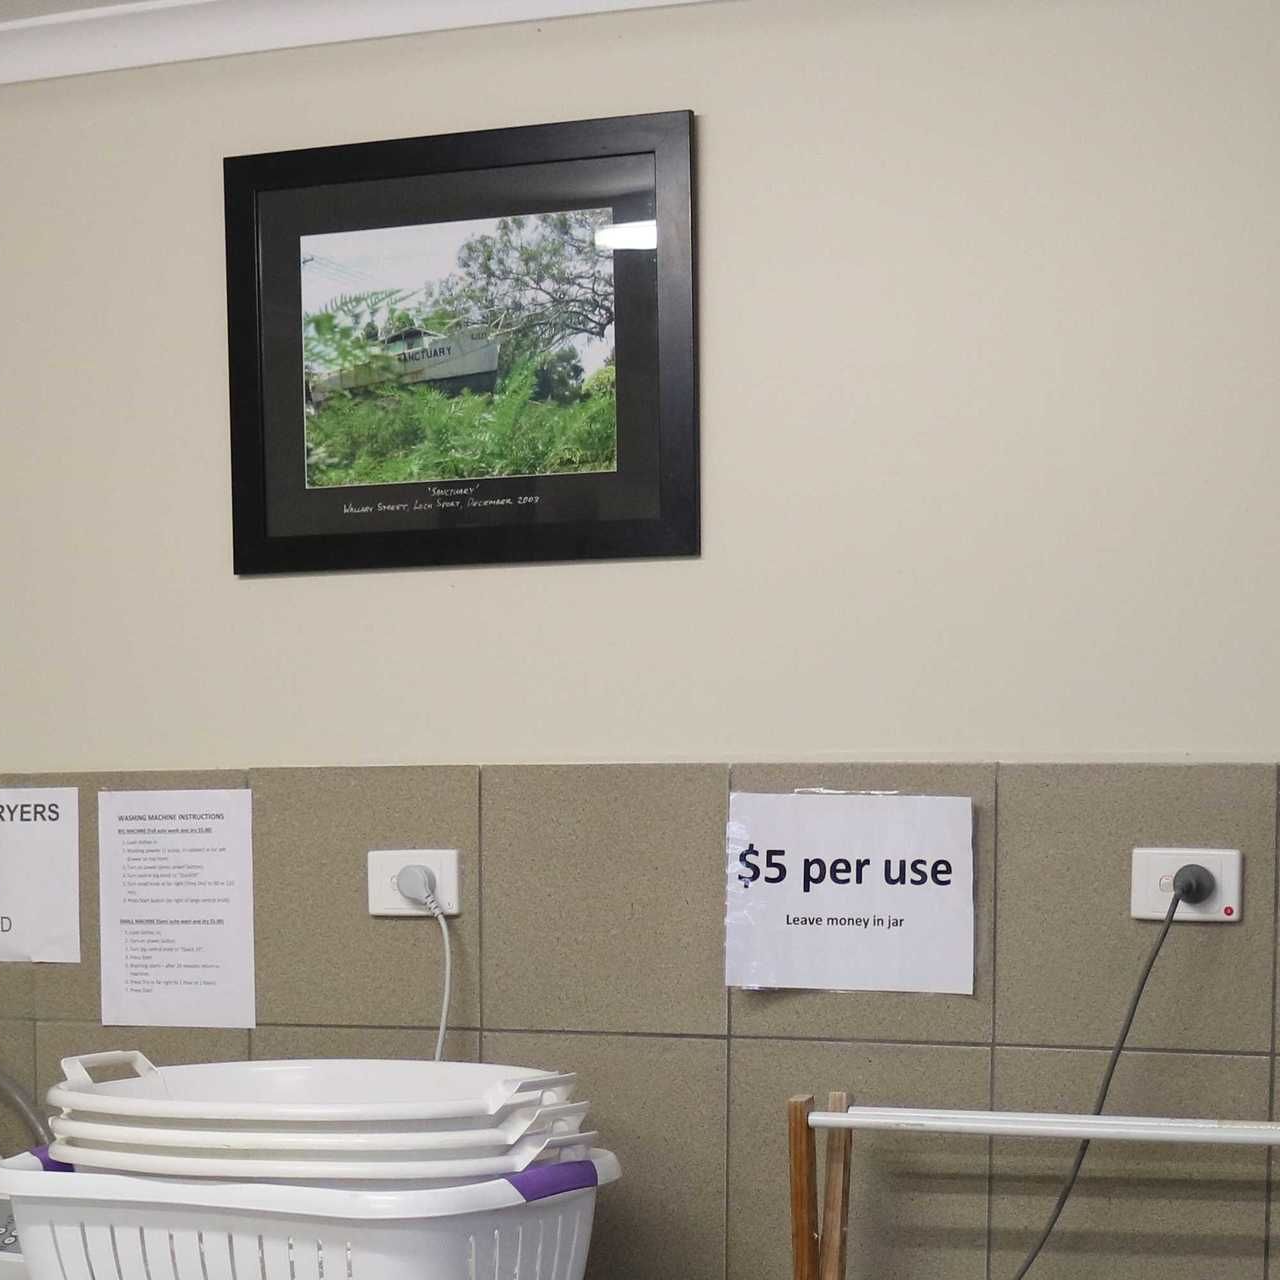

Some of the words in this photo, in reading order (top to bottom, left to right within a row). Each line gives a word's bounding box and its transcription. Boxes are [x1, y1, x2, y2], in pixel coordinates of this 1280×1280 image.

[118, 814, 147, 822] WASHING
[178, 813, 225, 821] INSTRUCTIONS
[737, 843, 787, 888] $5
[803, 858, 870, 892] per
[884, 858, 953, 886] use
[786, 914, 823, 926] Leave
[826, 916, 870, 929] money
[873, 915, 884, 927] in
[887, 915, 905, 929] jar
